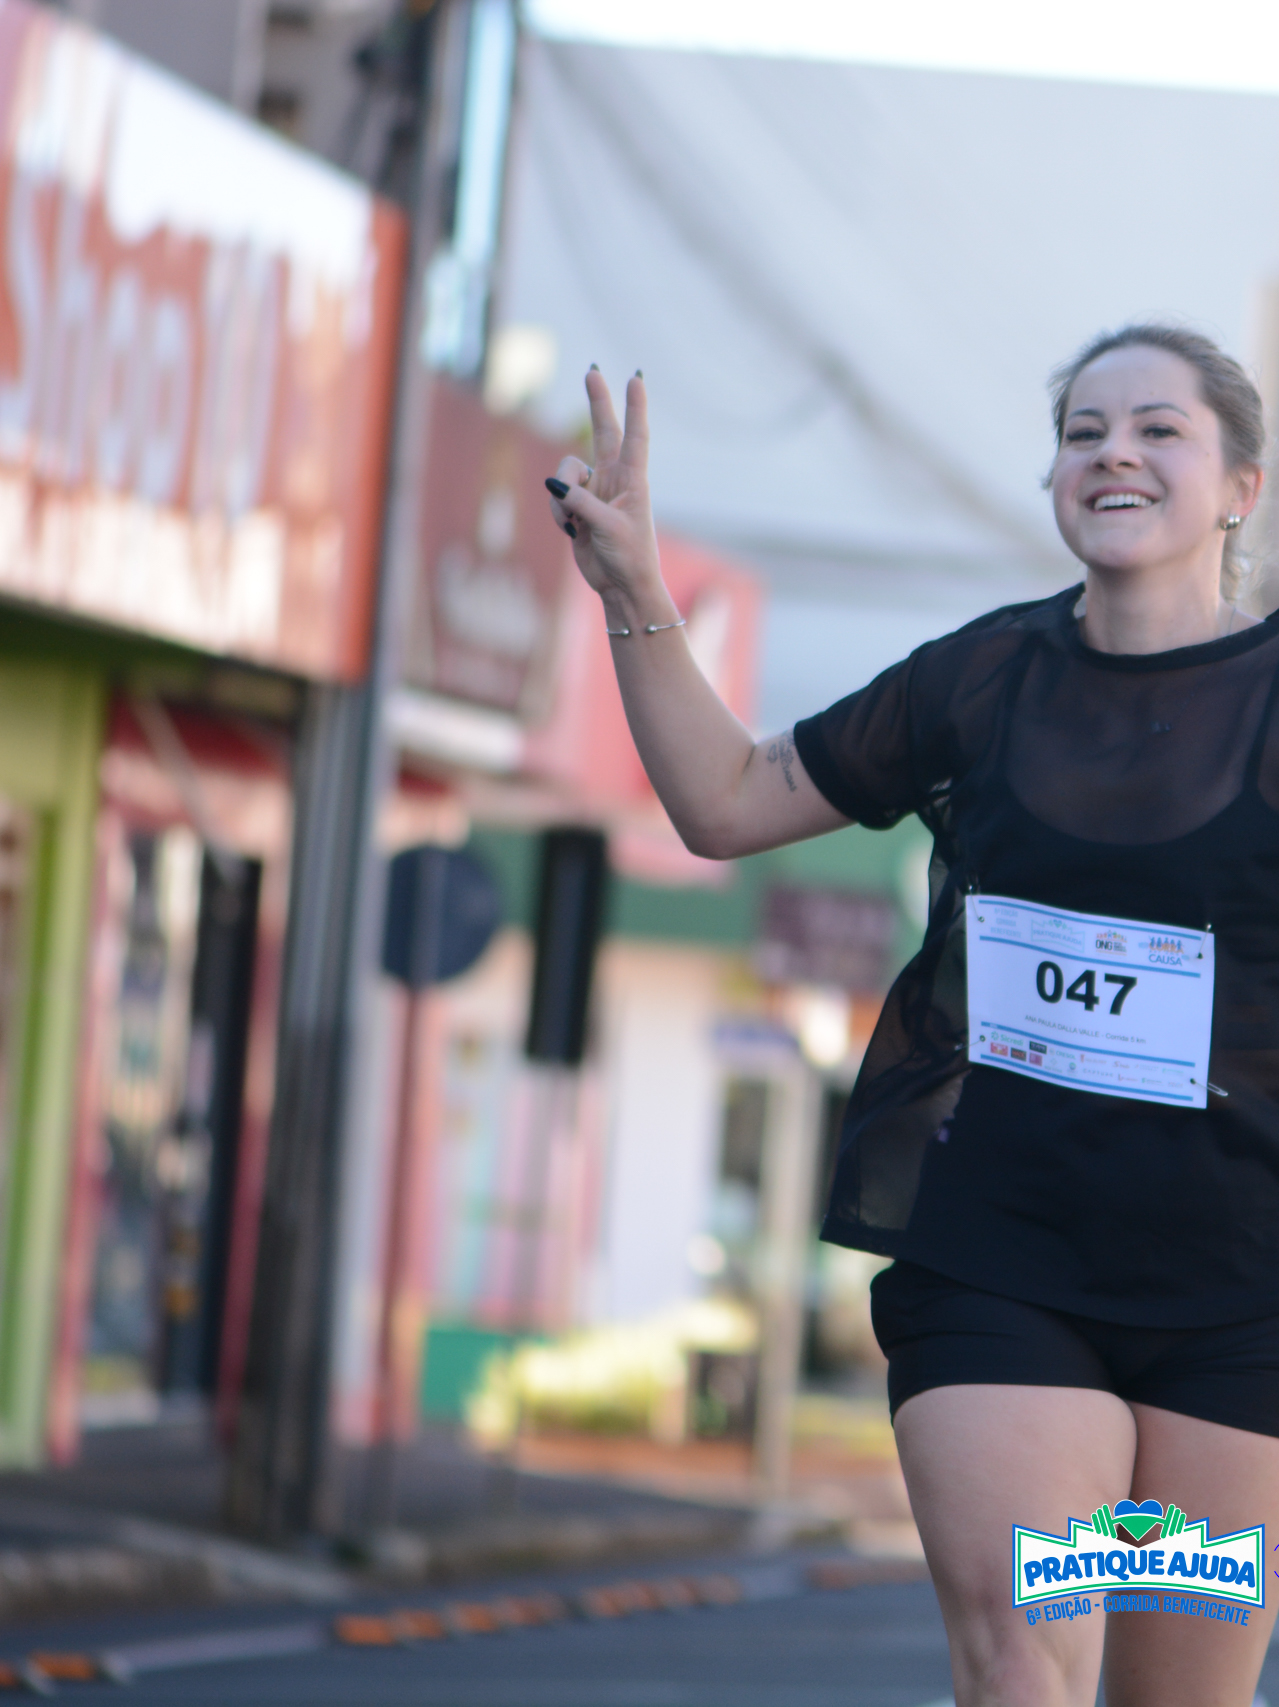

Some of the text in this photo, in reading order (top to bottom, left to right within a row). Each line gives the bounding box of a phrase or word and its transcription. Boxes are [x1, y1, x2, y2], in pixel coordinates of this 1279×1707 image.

[1095, 939, 1113, 951] ONG
[1148, 953, 1183, 967] CAUSA
[1036, 960, 1138, 1016] 047
[1024, 1014, 1037, 1023] ANA
[1037, 1017, 1057, 1029] PAULA
[1057, 1023, 1078, 1034] DALLA
[1078, 1028, 1100, 1038] VALLE
[1105, 1032, 1129, 1042] Corrida
[1136, 1036, 1147, 1044] km
[1000, 1033, 1024, 1046] Sicredi
